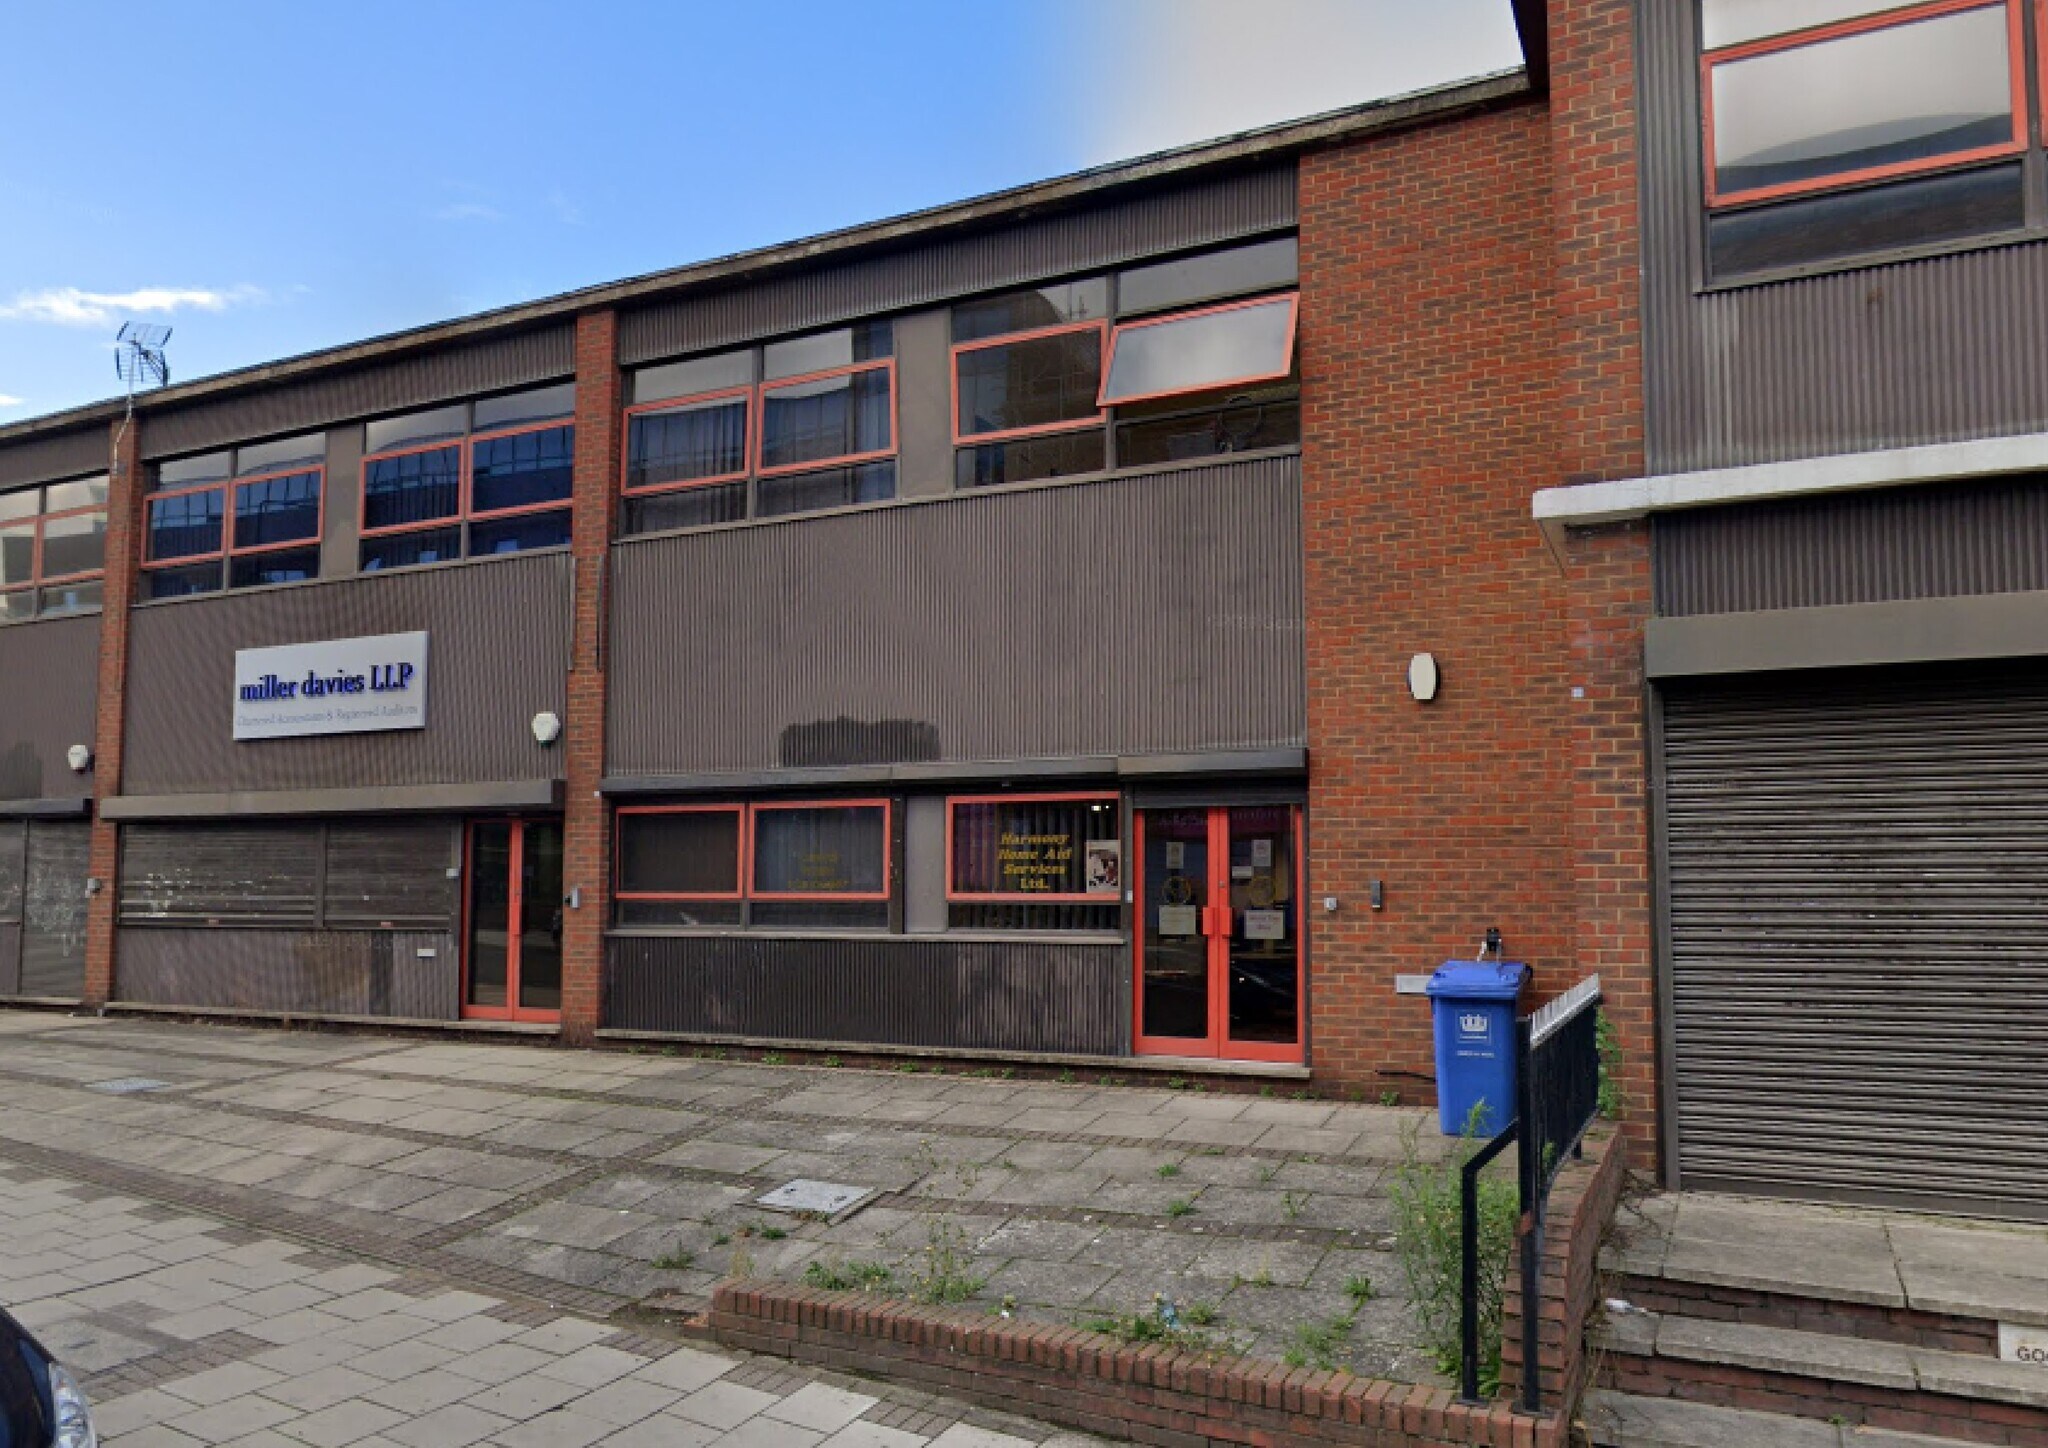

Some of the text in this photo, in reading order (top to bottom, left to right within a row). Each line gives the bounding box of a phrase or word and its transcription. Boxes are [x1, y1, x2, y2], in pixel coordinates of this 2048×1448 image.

[239, 661, 414, 700] miller davies LLP
